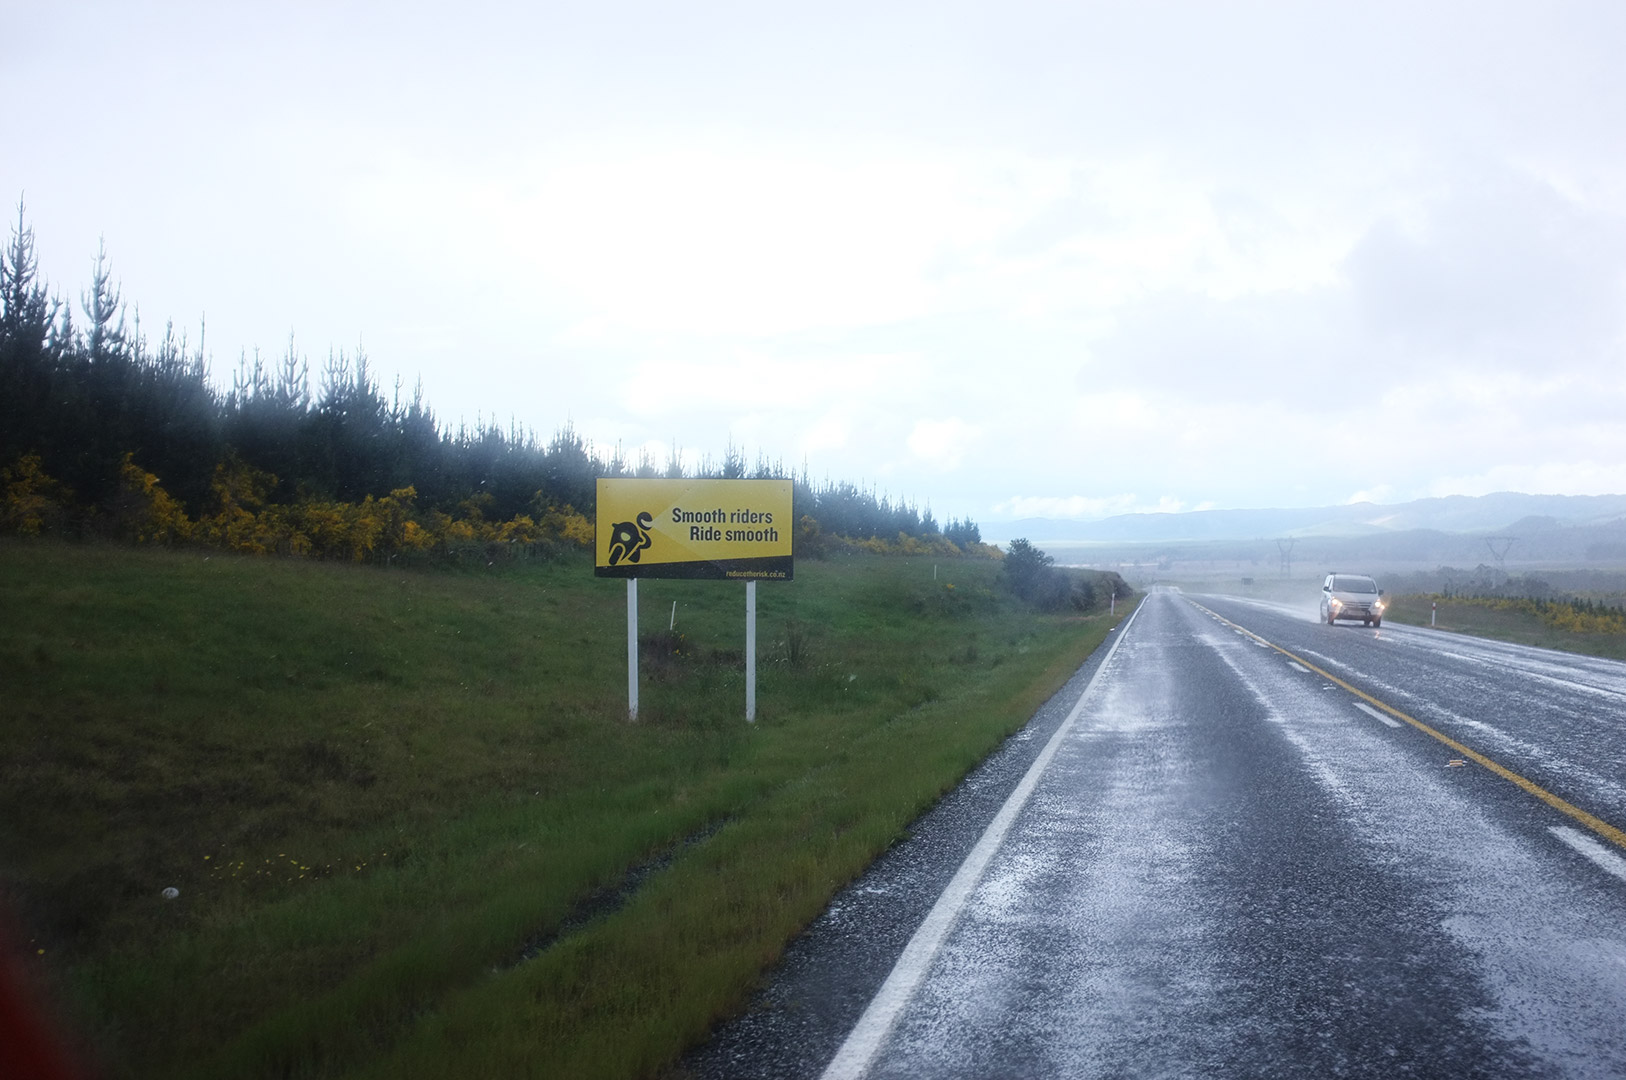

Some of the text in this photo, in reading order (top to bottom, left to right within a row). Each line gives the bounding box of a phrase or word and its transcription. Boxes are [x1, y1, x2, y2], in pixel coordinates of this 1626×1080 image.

[672, 507, 773, 524] Smooth riders
[690, 526, 778, 542] Ride smooth
[726, 570, 786, 578] reducetherisk.co.nz
